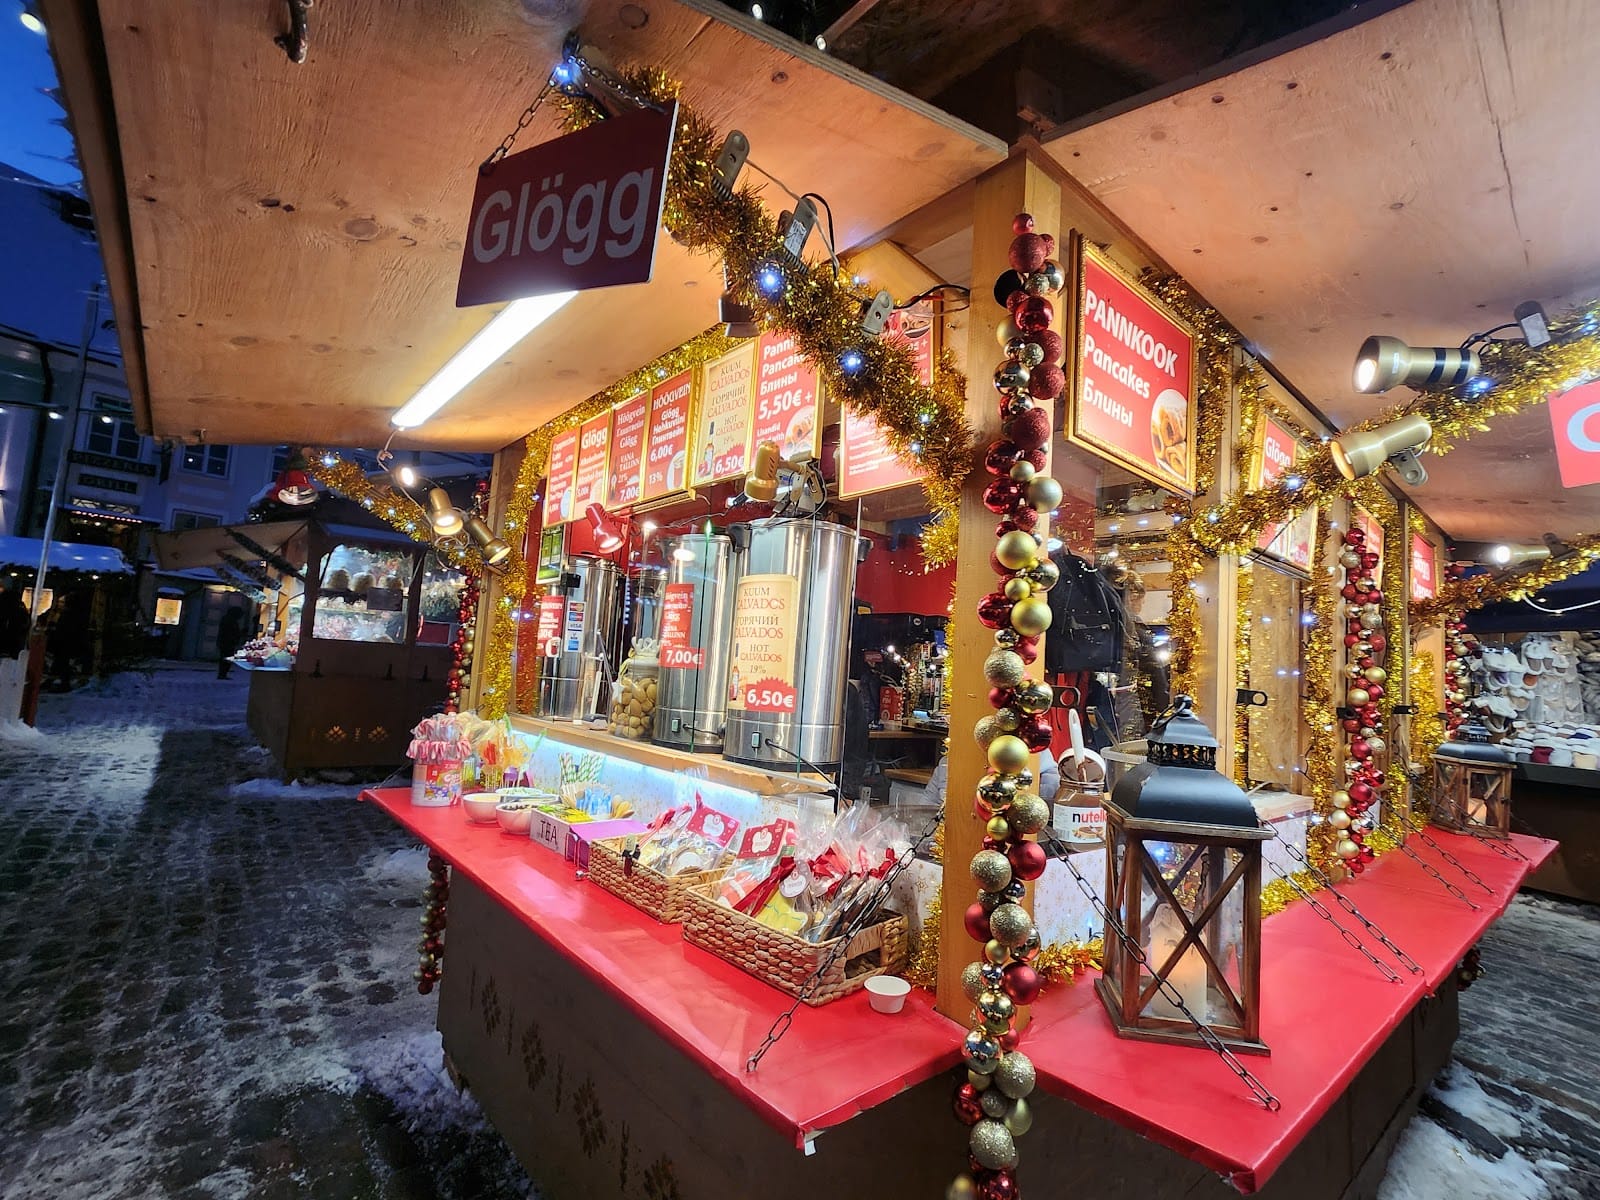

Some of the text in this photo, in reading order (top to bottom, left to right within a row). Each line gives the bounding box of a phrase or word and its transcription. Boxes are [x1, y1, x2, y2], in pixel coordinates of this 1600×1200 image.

[472, 167, 655, 266] Glögg
[1085, 288, 1178, 378] PANNKOOK
[1083, 333, 1150, 399] Pancakes
[710, 368, 751, 392] CALVADOS
[760, 371, 798, 397] Блины
[757, 388, 803, 421] 5,50€
[1083, 376, 1133, 428] Блины
[581, 427, 608, 449] Glögg
[650, 444, 674, 462] 6,00€
[714, 454, 744, 474] 6,50€
[743, 587, 770, 597] KUUM
[666, 649, 703, 665] 7,00€
[740, 652, 783, 663] CALVADOS
[749, 644, 769, 653] HOT
[747, 688, 794, 708] 6,50€
[1072, 811, 1107, 824] nutell
[540, 819, 558, 845] TEA
